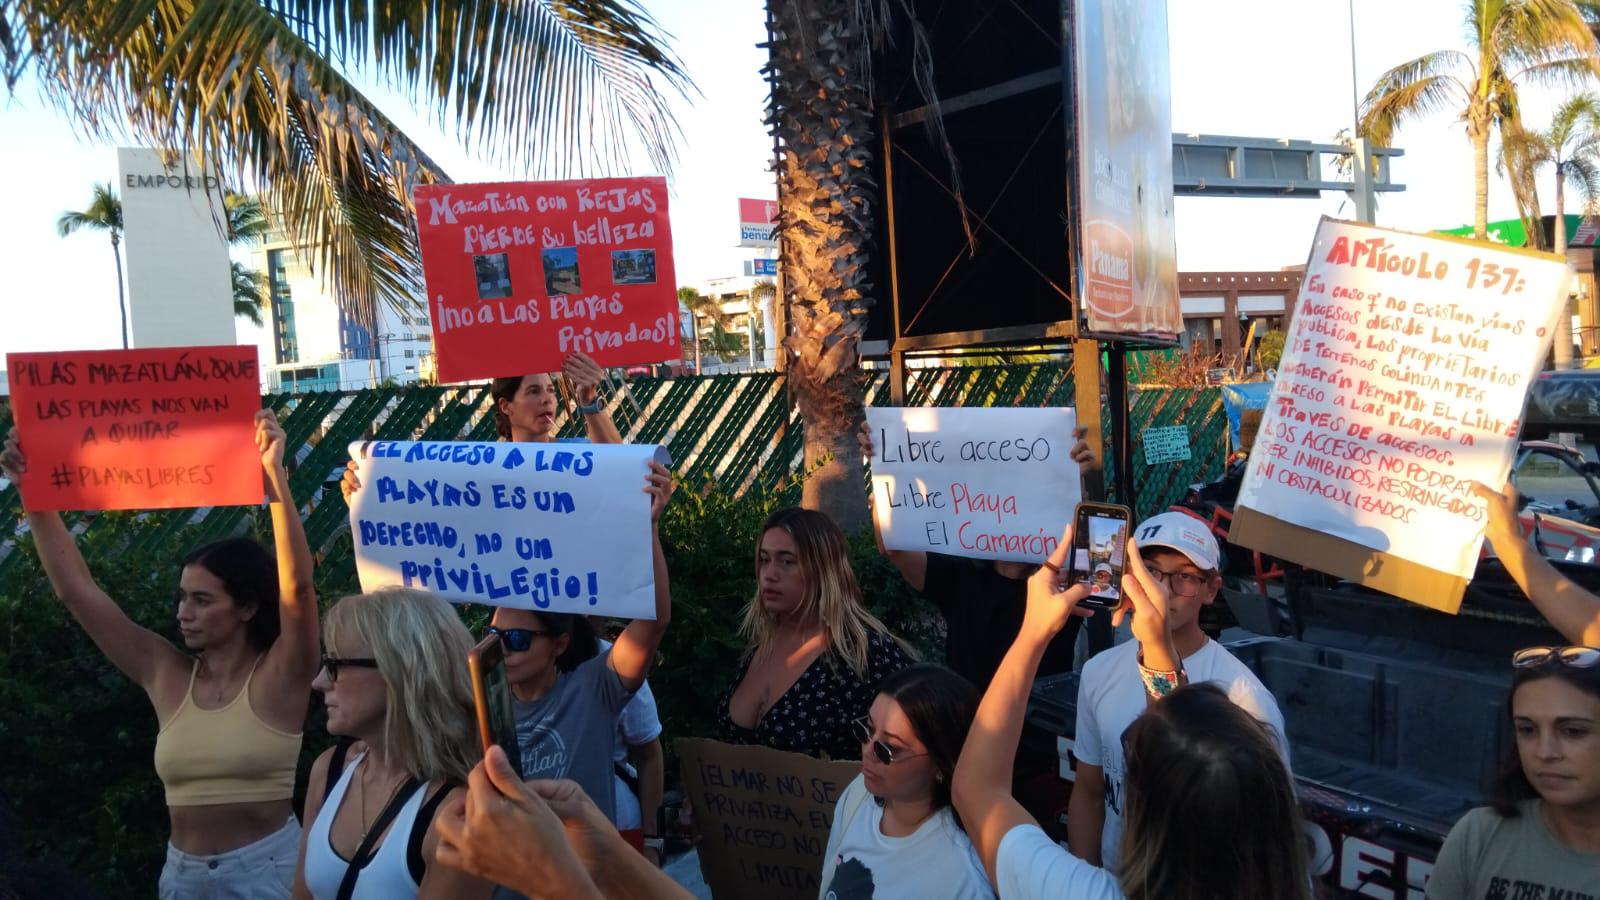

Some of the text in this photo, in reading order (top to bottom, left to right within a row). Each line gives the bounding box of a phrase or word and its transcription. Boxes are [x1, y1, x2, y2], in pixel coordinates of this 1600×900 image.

[126, 174, 218, 189] EMPORIO
[741, 227, 771, 240] bena
[1465, 258, 1526, 295] 137:
[14, 351, 256, 387] PILAS MAZATLÁN, QUE
[37, 395, 229, 420] LAS PLAYAS NOS VAN
[81, 420, 181, 448] A QUITAR
[881, 428, 1051, 464] Libre acceso
[1347, 423, 1373, 440] DE
[502, 447, 525, 470] A
[535, 450, 594, 477] LAS
[1301, 429, 1379, 467] ACCESOS
[1378, 455, 1405, 473] NO
[51, 464, 217, 489] #PLAYASLIBRES
[1256, 461, 1275, 480] NI
[1294, 450, 1376, 489] INHIBIDOS,
[376, 476, 481, 508] PLAYAS
[491, 483, 526, 510] ES
[885, 481, 1017, 525] Libre Playa
[925, 521, 1058, 557] El Camarón
[731, 768, 769, 793] MAR
[776, 776, 804, 798] NO
[811, 777, 837, 804] SE
[793, 836, 822, 858] NO
